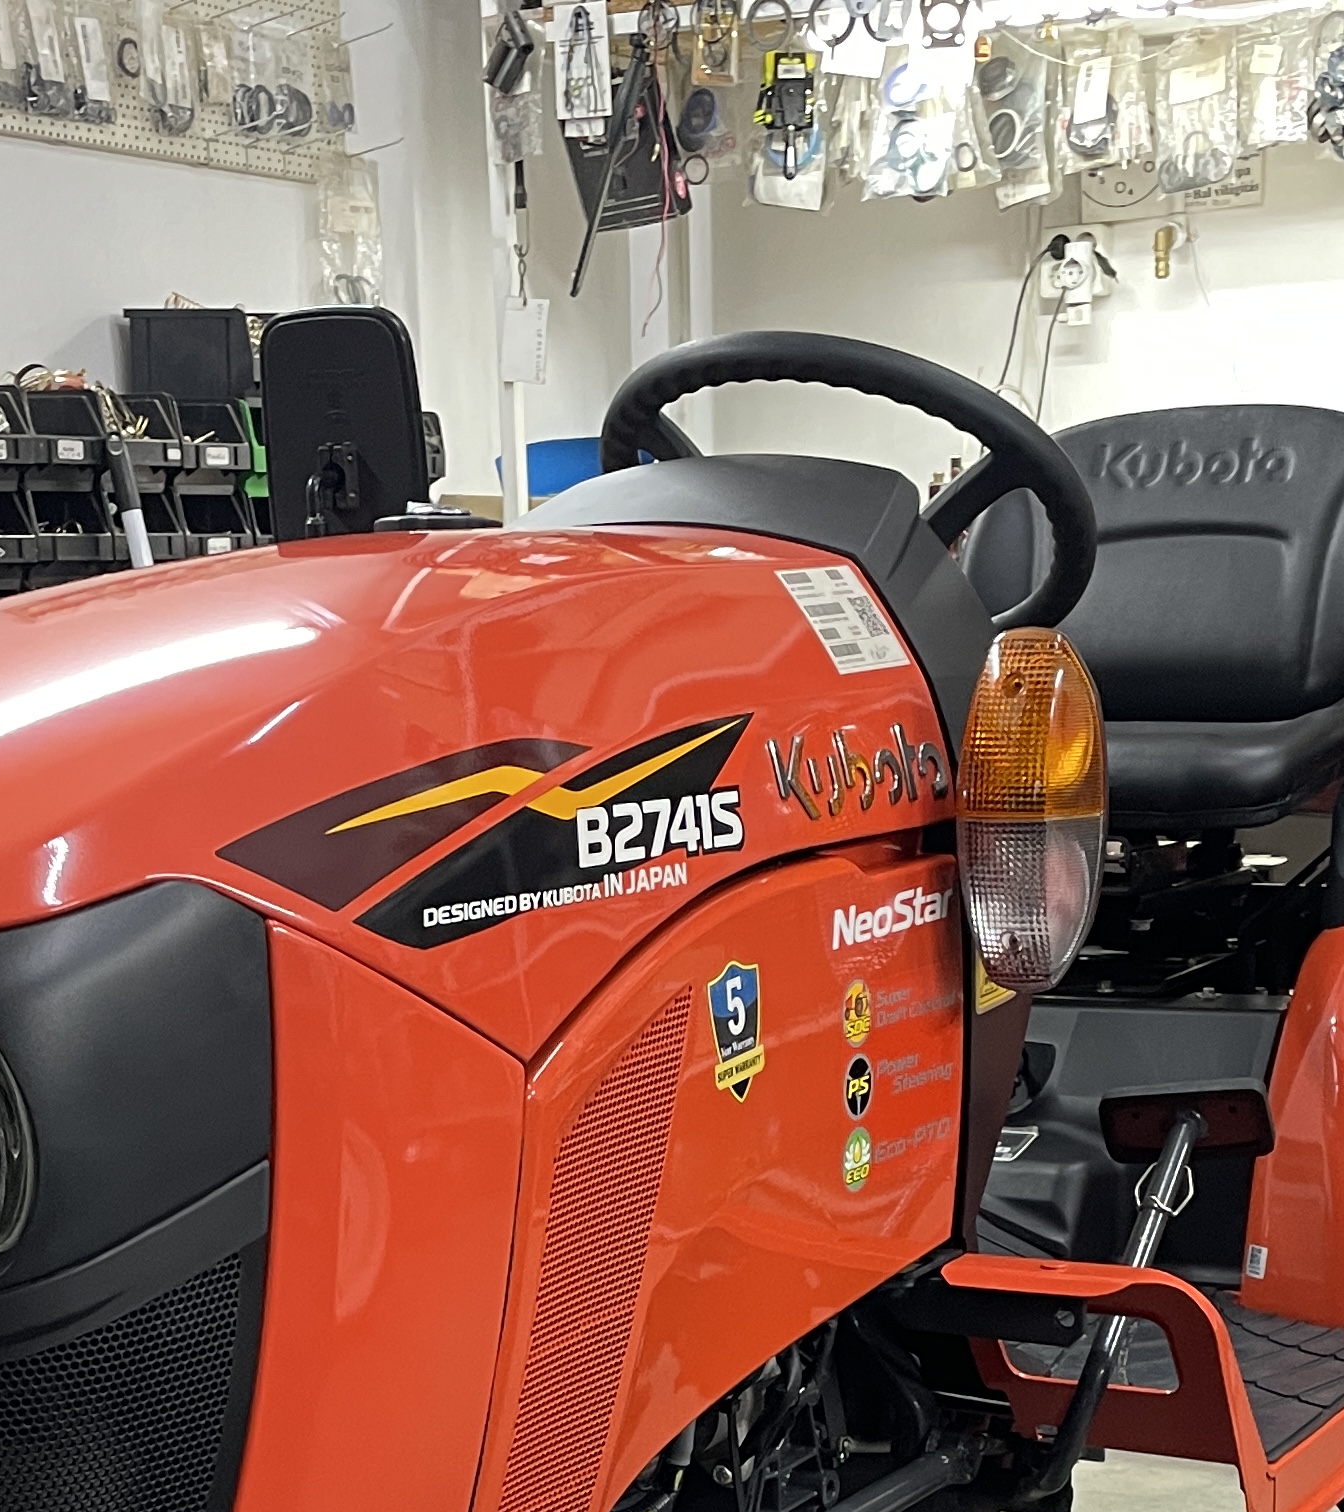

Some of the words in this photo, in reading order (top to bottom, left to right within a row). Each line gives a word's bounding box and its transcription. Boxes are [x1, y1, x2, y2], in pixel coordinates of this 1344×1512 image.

[1090, 436, 1297, 489] Kubota
[765, 722, 949, 821] Kubota
[576, 789, 744, 869] B2741S
[422, 894, 518, 927] DESIGNED
[519, 891, 542, 912] BY
[542, 882, 602, 909] KUBOTA
[603, 871, 623, 898] IN
[625, 861, 688, 895] JAPAN
[831, 886, 954, 951] NeoStar
[726, 975, 746, 1036] 5
[847, 1075, 870, 1100] PS
